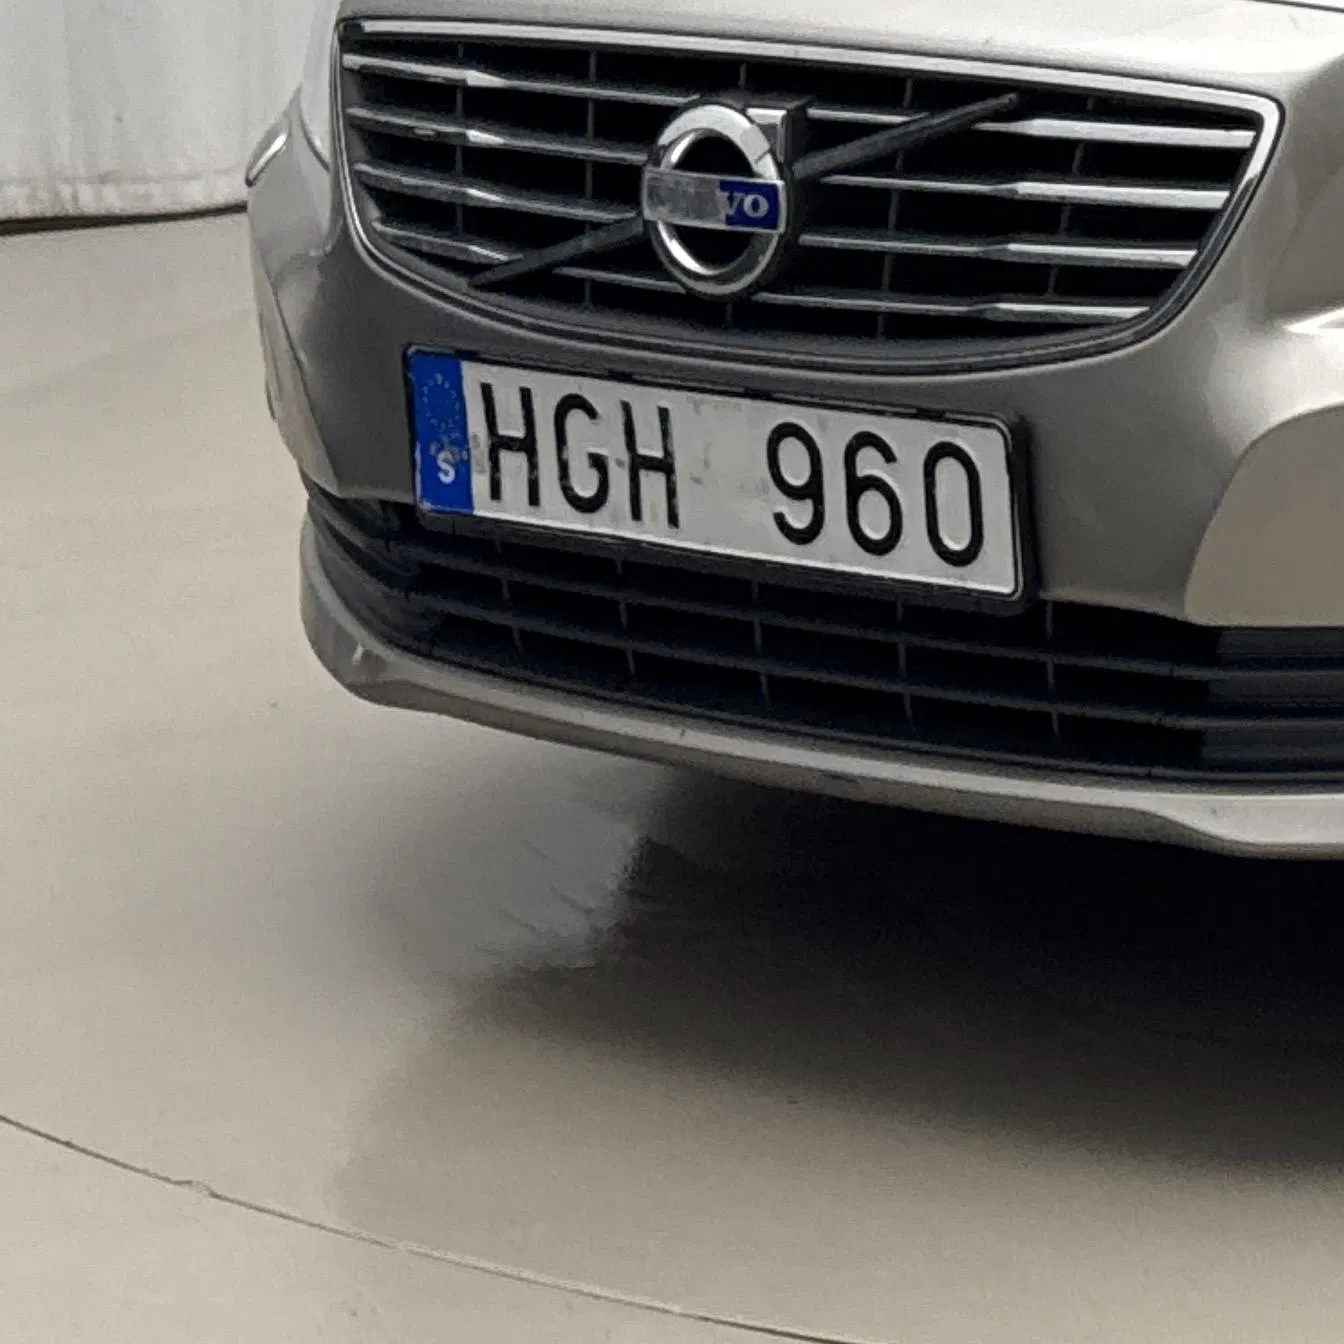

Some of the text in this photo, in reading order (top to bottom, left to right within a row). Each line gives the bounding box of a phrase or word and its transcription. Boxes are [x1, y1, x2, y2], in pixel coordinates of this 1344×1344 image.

[436, 450, 456, 485] S
[479, 381, 986, 568] HGH 960
